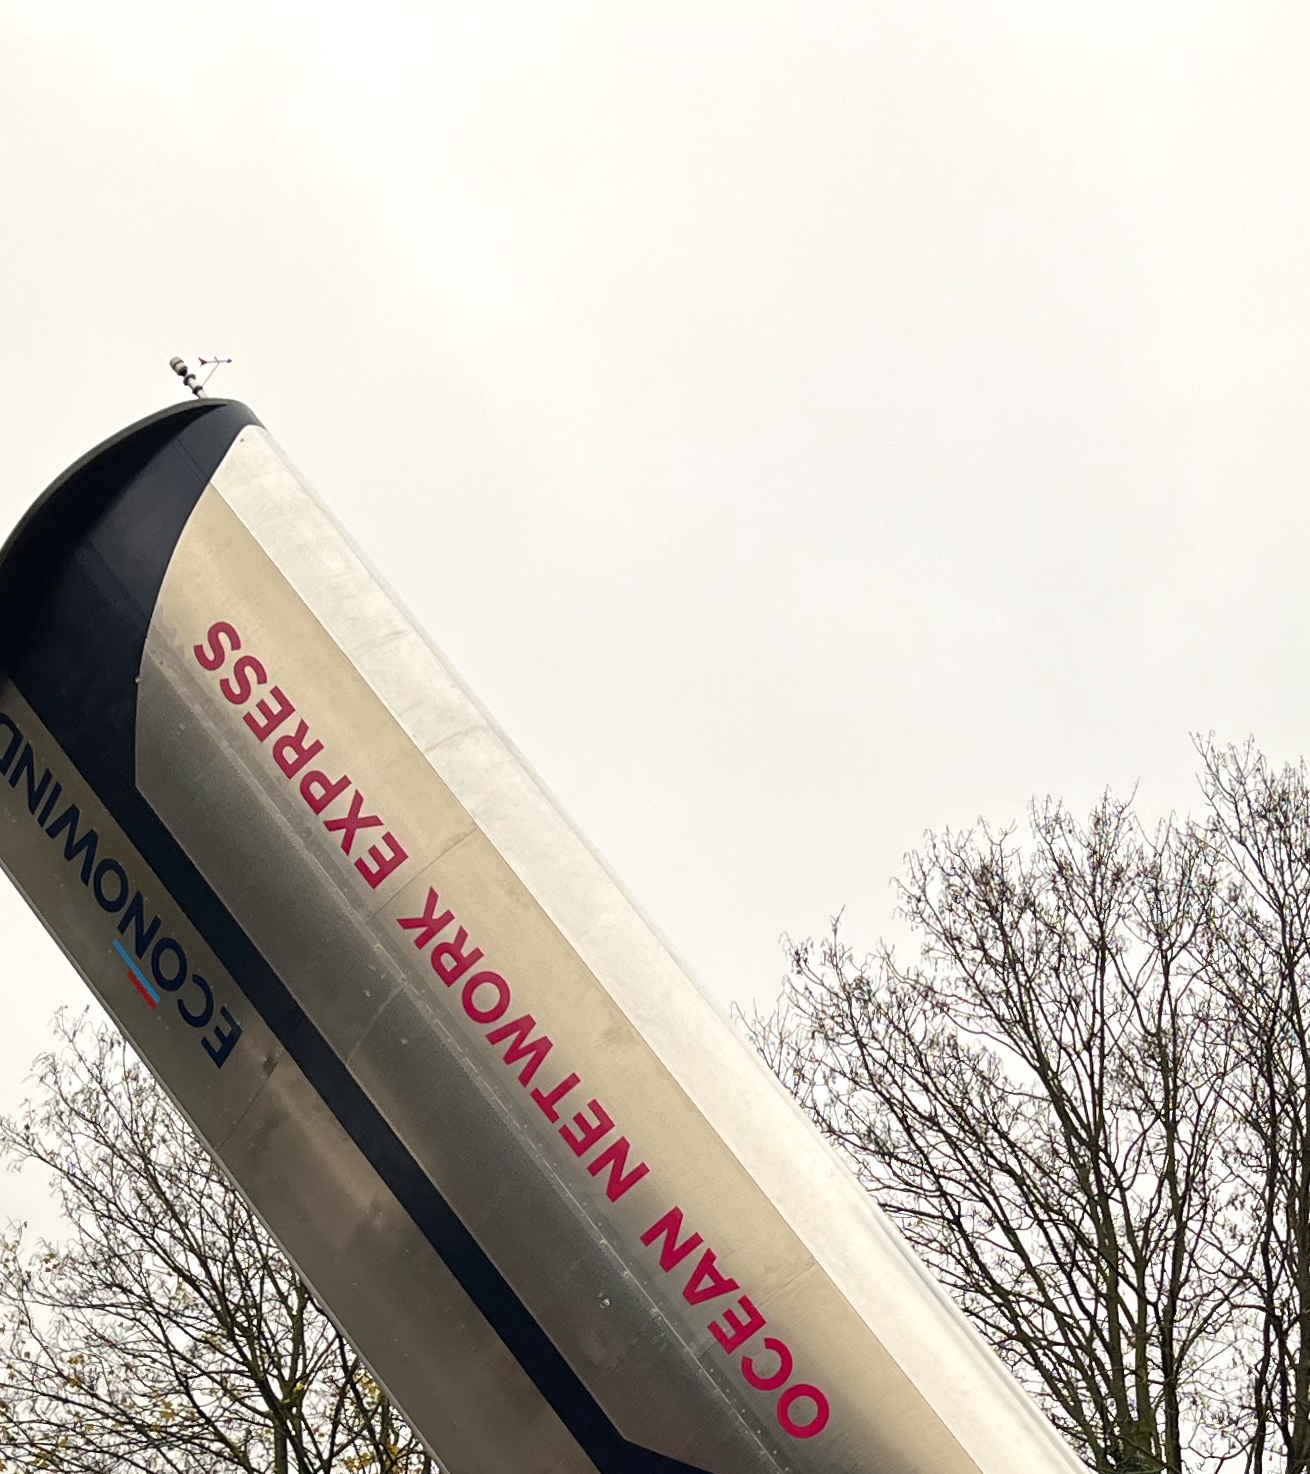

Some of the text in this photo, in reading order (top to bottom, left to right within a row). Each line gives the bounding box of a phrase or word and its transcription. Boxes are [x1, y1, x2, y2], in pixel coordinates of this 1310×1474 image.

[193, 621, 829, 1439] OCEAN NETWORK EXPRESS
